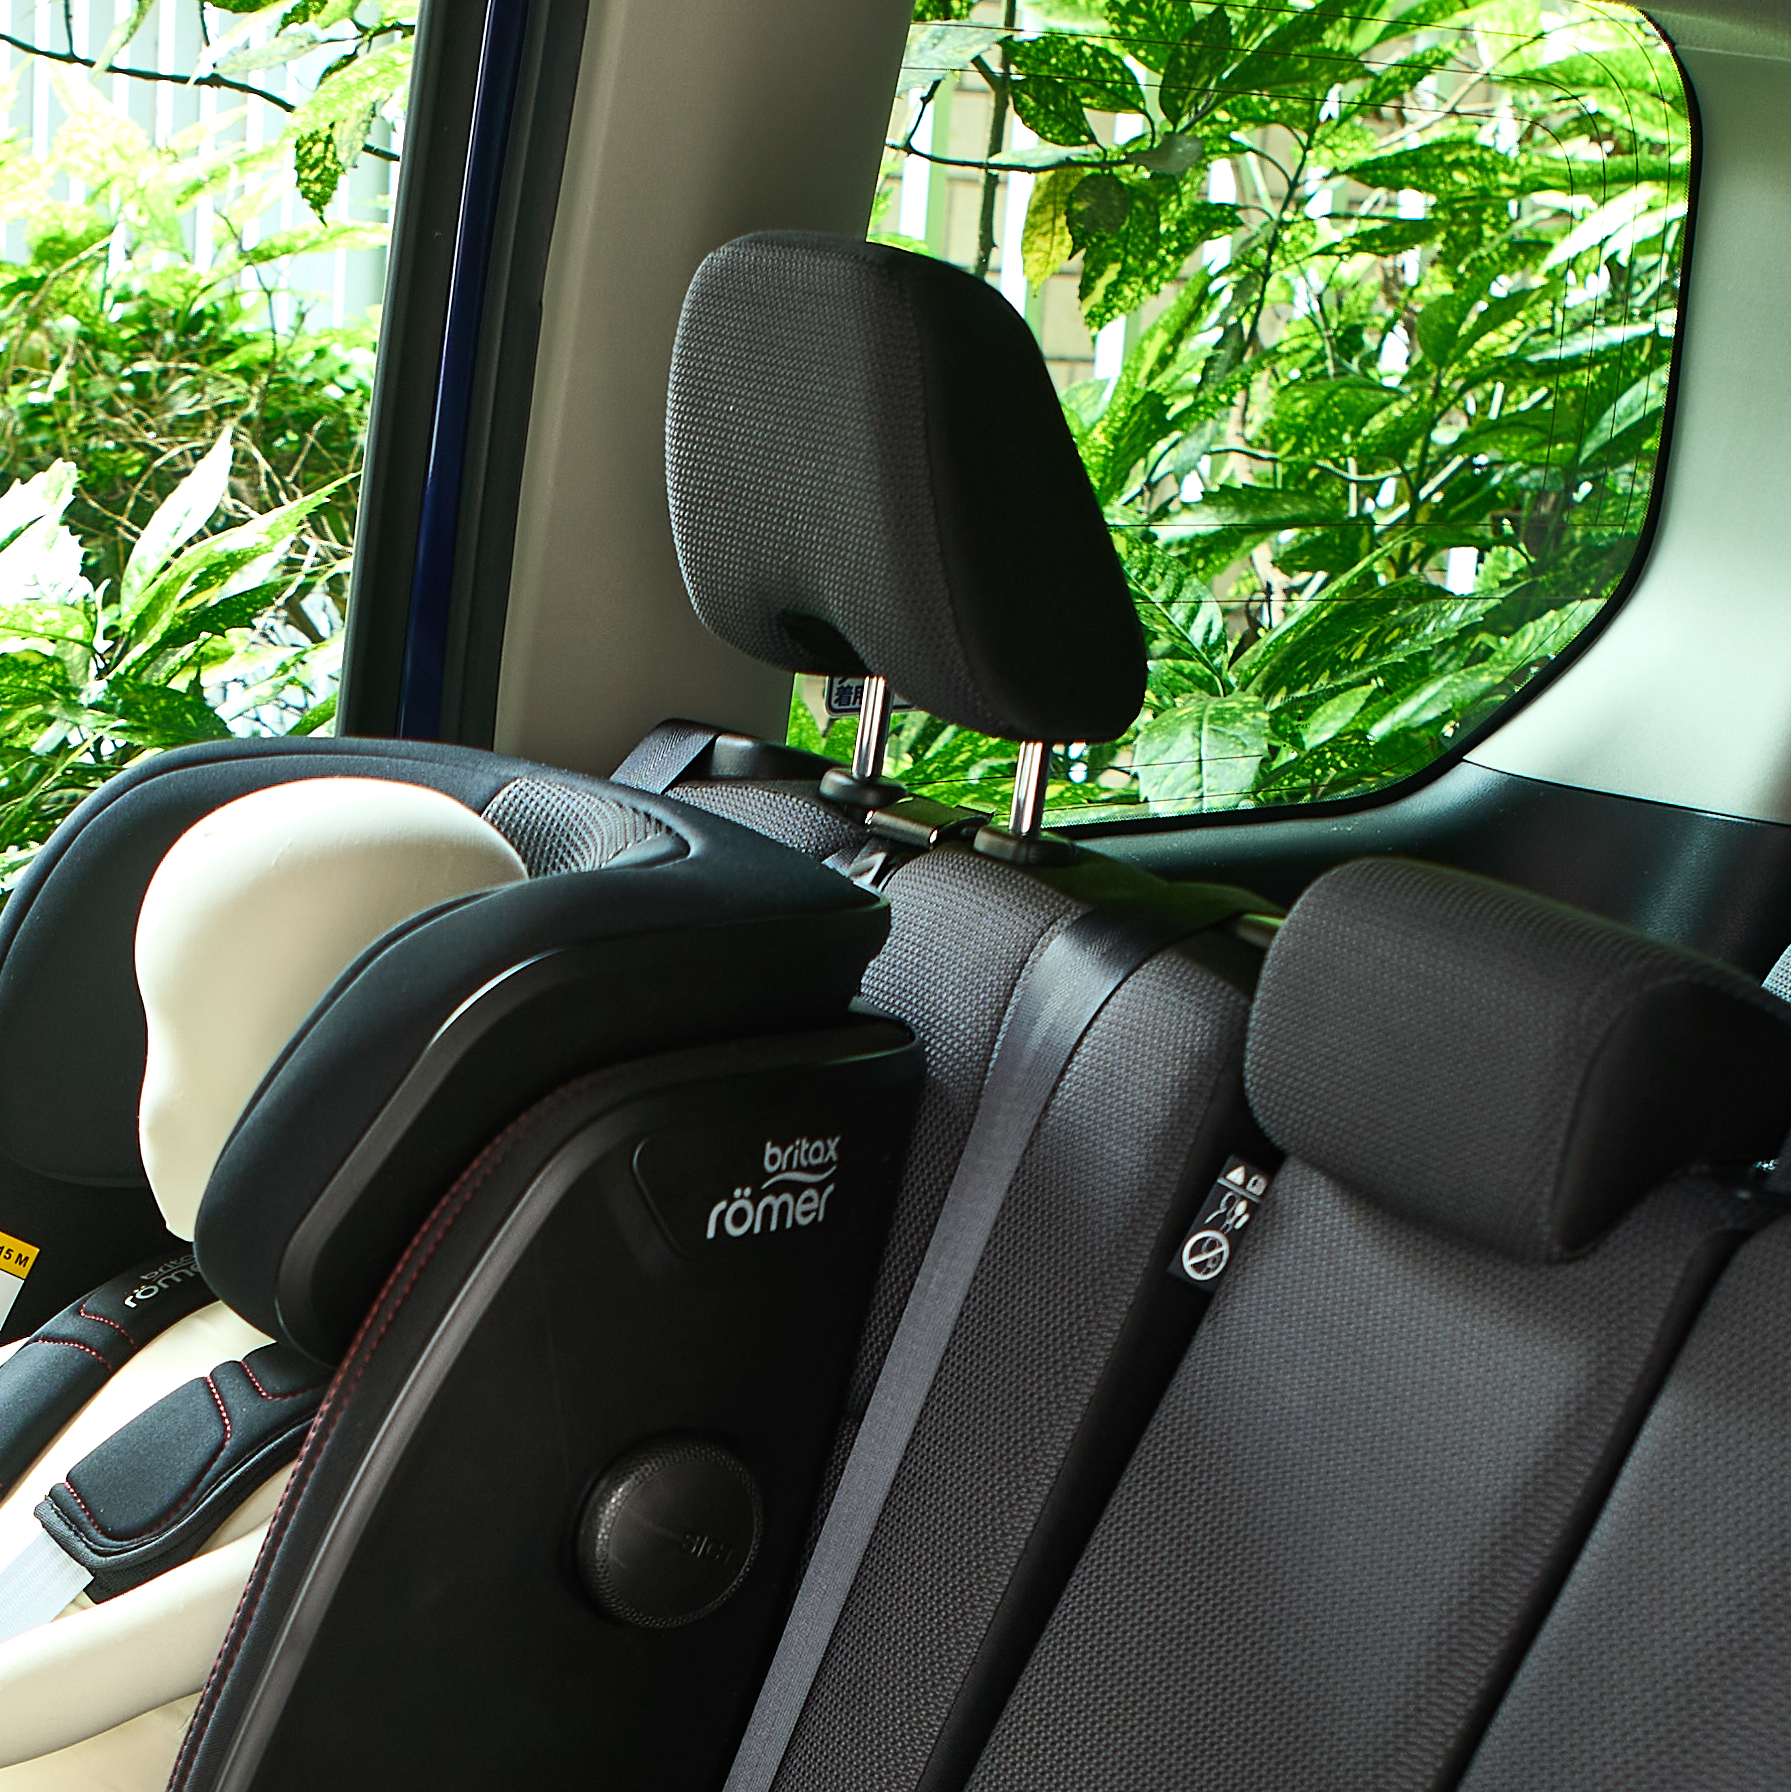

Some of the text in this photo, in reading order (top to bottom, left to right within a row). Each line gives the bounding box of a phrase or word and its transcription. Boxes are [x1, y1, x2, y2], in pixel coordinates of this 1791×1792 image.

[763, 1135, 841, 1174] britax
[706, 1183, 836, 1239] römer
[14, 1253, 30, 1268] M
[140, 1254, 195, 1280] brita
[124, 1264, 201, 1309] röme
